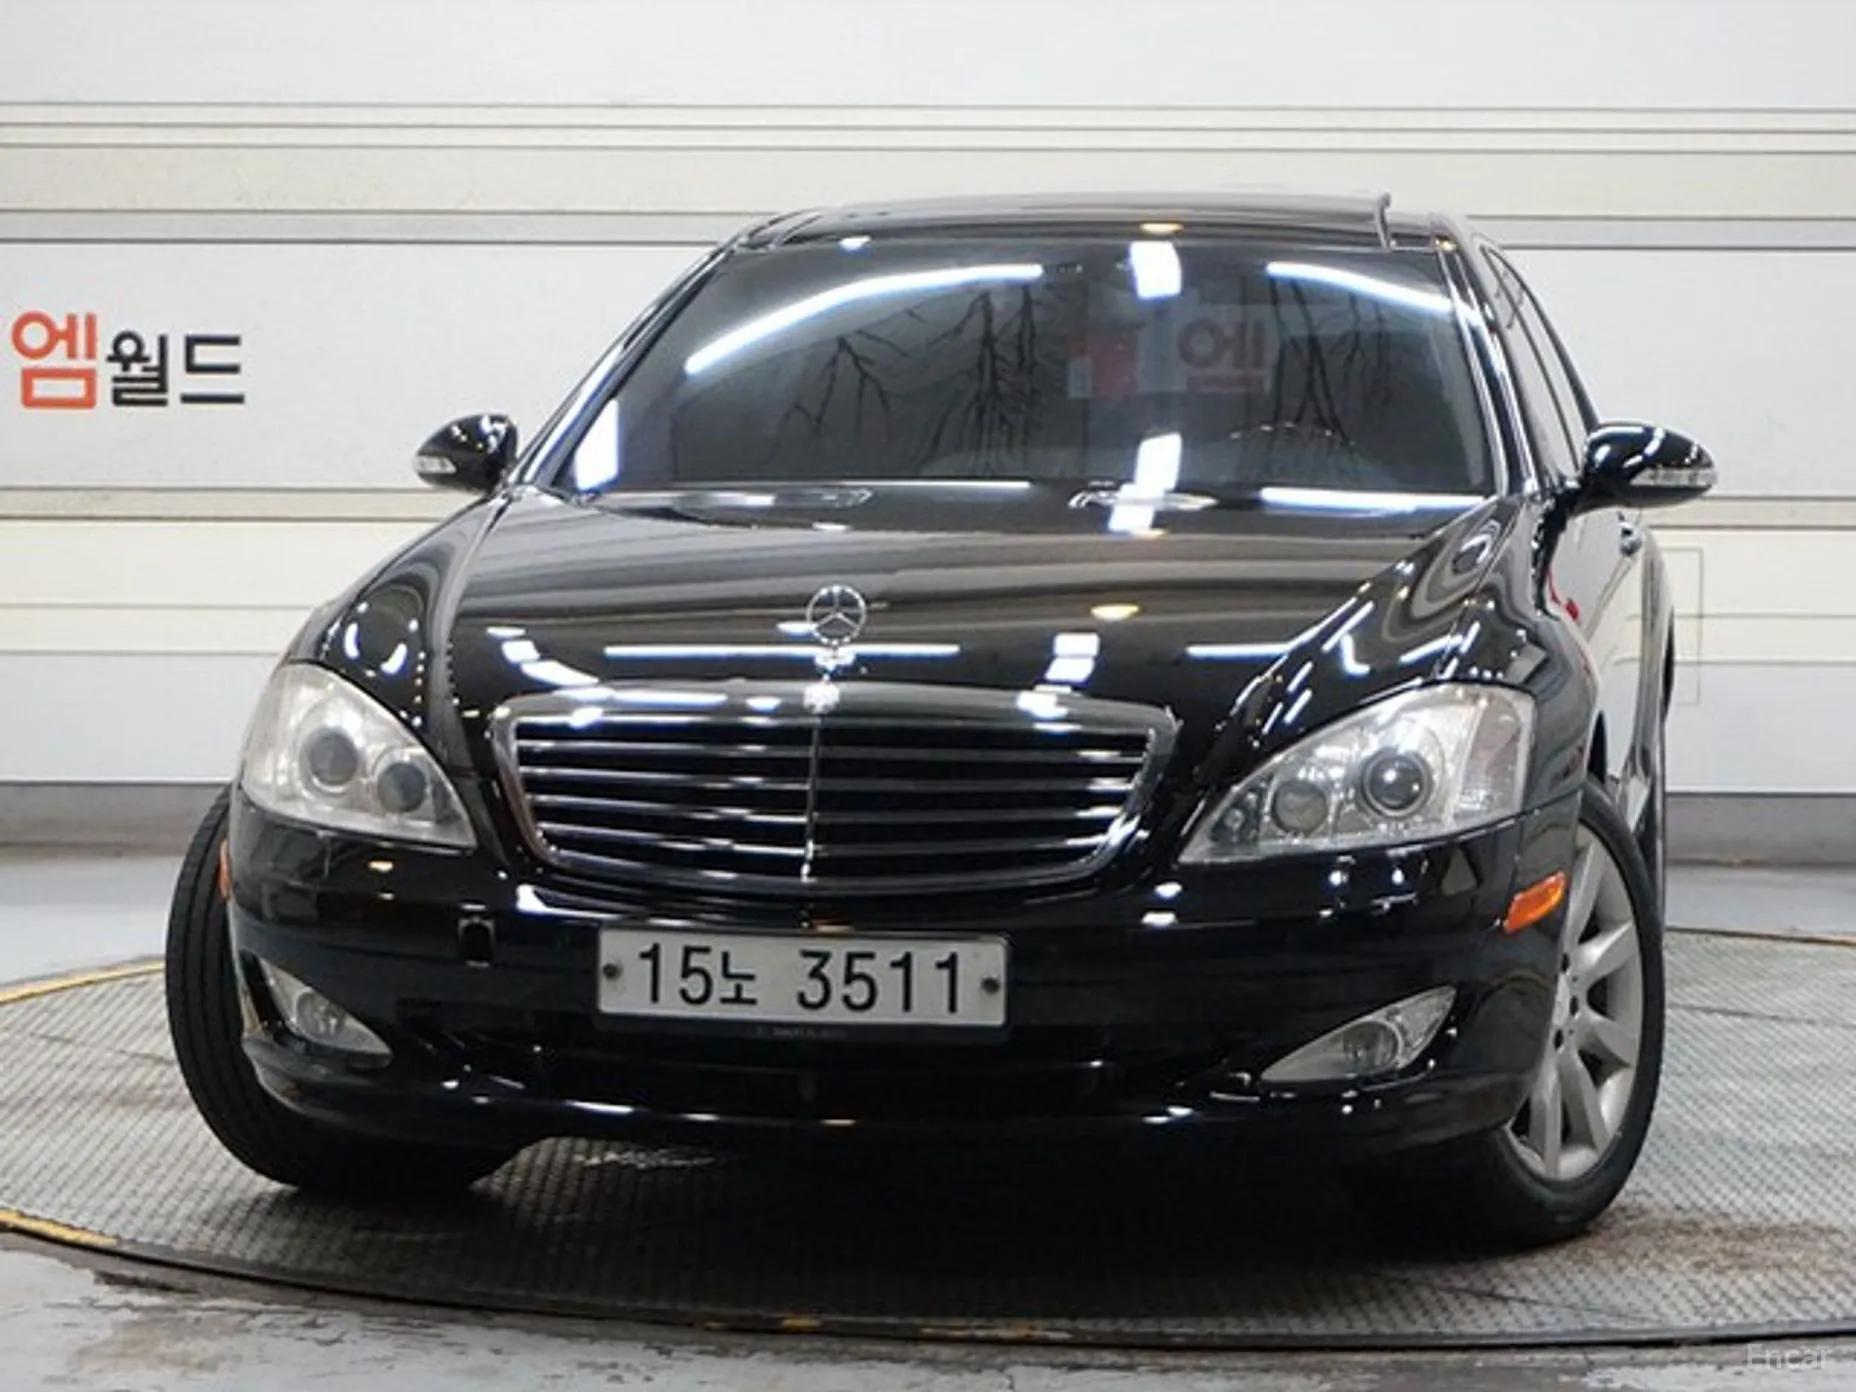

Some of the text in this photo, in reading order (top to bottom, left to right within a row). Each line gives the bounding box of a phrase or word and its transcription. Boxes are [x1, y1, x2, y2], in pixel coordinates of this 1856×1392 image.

[11, 309, 246, 410] 엠월드
[638, 942, 959, 1014] 15노 3511
